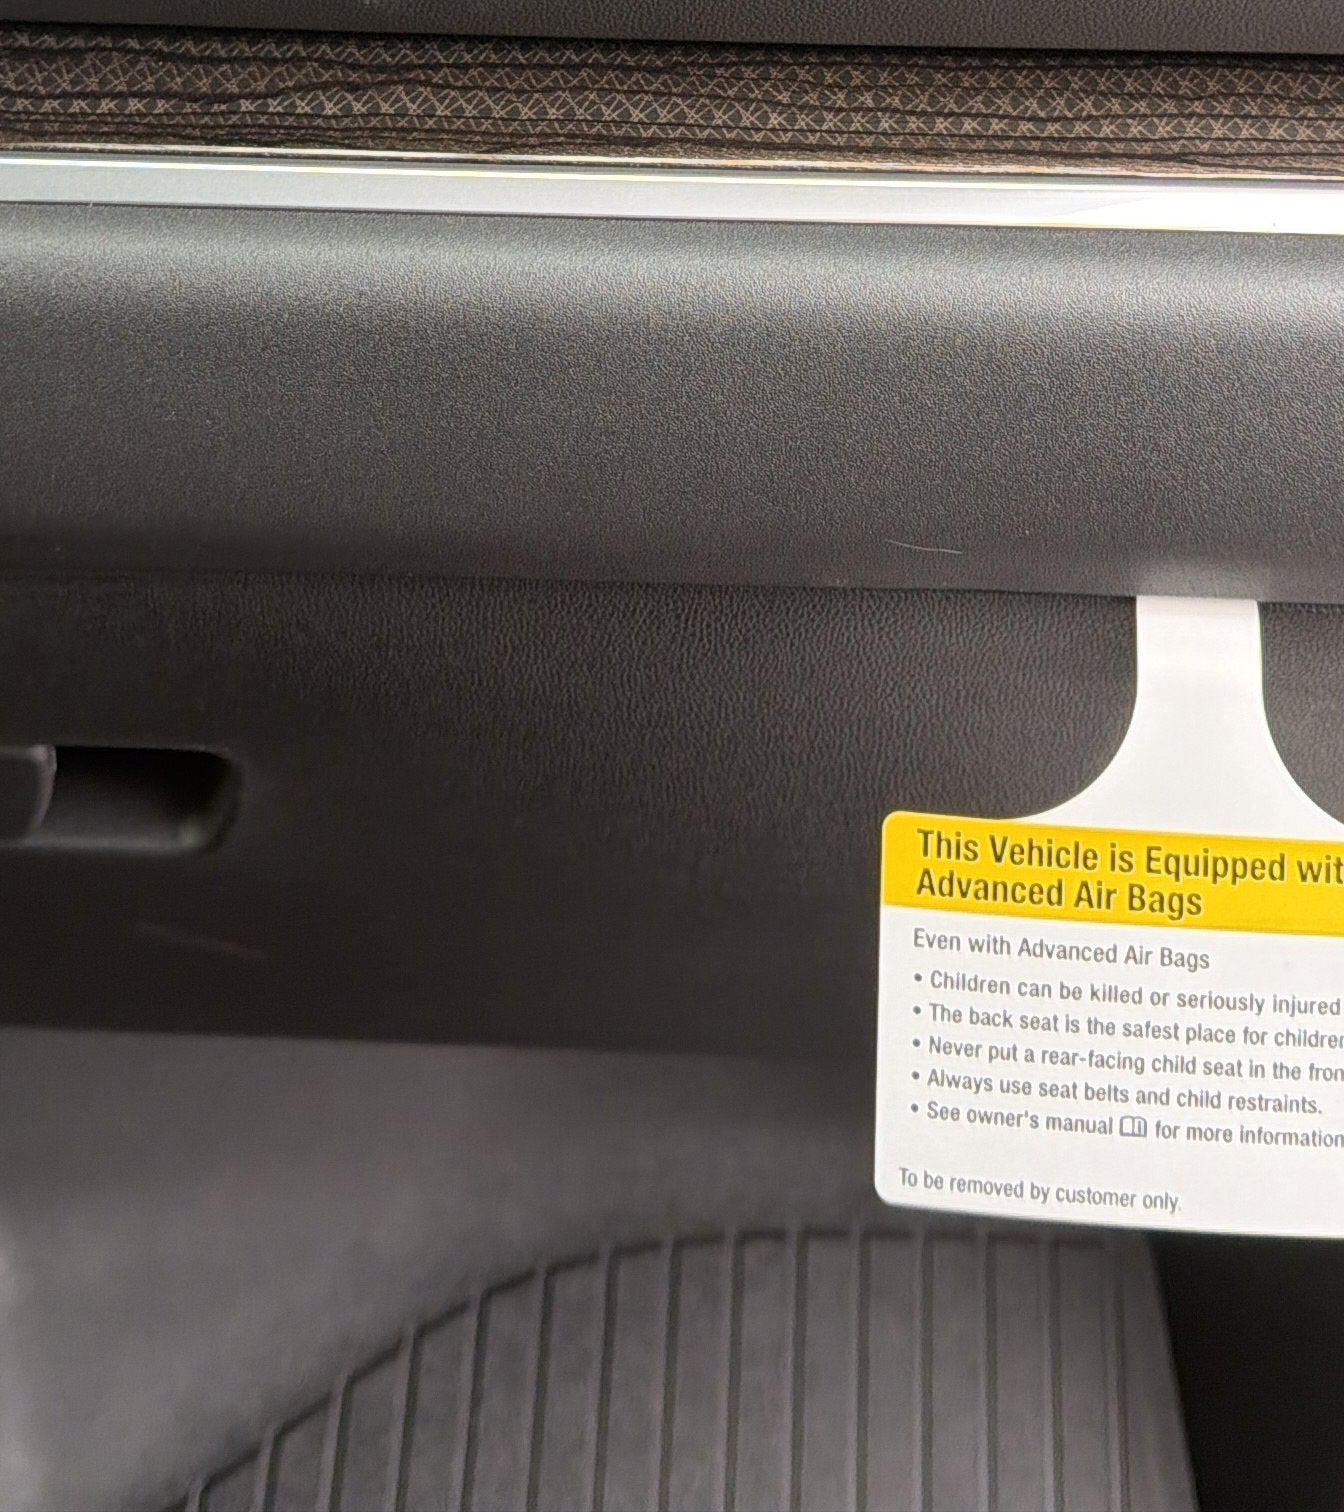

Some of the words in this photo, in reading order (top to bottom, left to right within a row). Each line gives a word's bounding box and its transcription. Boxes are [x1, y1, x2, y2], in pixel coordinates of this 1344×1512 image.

[917, 828, 978, 862] This
[989, 834, 1098, 871] Vehicle
[1110, 842, 1134, 873] is
[1146, 846, 1285, 886] Equipped
[916, 868, 1063, 907] Advanced
[1073, 880, 1117, 910] Air
[1128, 883, 1202, 921] Bags
[914, 928, 961, 952] Even
[968, 934, 1011, 956] with
[1017, 937, 1117, 963] Advanced
[1124, 945, 1153, 965] Air
[1160, 947, 1210, 973] Bags
[930, 970, 1010, 995] Children
[1018, 982, 1052, 999] can
[1060, 981, 1082, 1001] be
[1090, 983, 1142, 1005] killed
[1150, 991, 1170, 1006] or
[1177, 990, 1265, 1016] seriously
[1273, 994, 1341, 1018] injured
[929, 1002, 962, 1024] The
[969, 1006, 1013, 1028] back
[1020, 1014, 1059, 1032] seat
[1065, 1014, 1080, 1034] is
[1087, 1017, 1116, 1036] the
[1122, 1021, 1179, 1041] safest
[1186, 1023, 1235, 1045] place
[1243, 1026, 1268, 1045] for
[929, 1035, 983, 1058] Never
[988, 1044, 1018, 1064] put
[1024, 1048, 1035, 1063] a
[1041, 1049, 1145, 1075] rear-facing
[1151, 1054, 1196, 1075] child
[1203, 1059, 1243, 1078] seat
[1249, 1059, 1265, 1078] in
[1273, 1062, 1301, 1081] the
[927, 1068, 993, 1095] Always
[1000, 1079, 1032, 1096] use
[1039, 1082, 1078, 1100] seat
[1084, 1082, 1129, 1103] belts
[1136, 1088, 1170, 1106] and
[1177, 1089, 1221, 1109] child
[1228, 1094, 1322, 1114] restraints.
[927, 1101, 960, 1122] See
[967, 1108, 1039, 1129] owner's
[1046, 1116, 1113, 1135] manual
[1155, 1120, 1180, 1139] for
[1186, 1126, 1233, 1143] more
[1240, 1125, 1344, 1148] information
[899, 1167, 918, 1187] To
[924, 1170, 944, 1190] be
[950, 1177, 1024, 1198] removed
[1030, 1182, 1050, 1204] by
[1056, 1187, 1137, 1208] customer
[1143, 1192, 1181, 1214] only.
